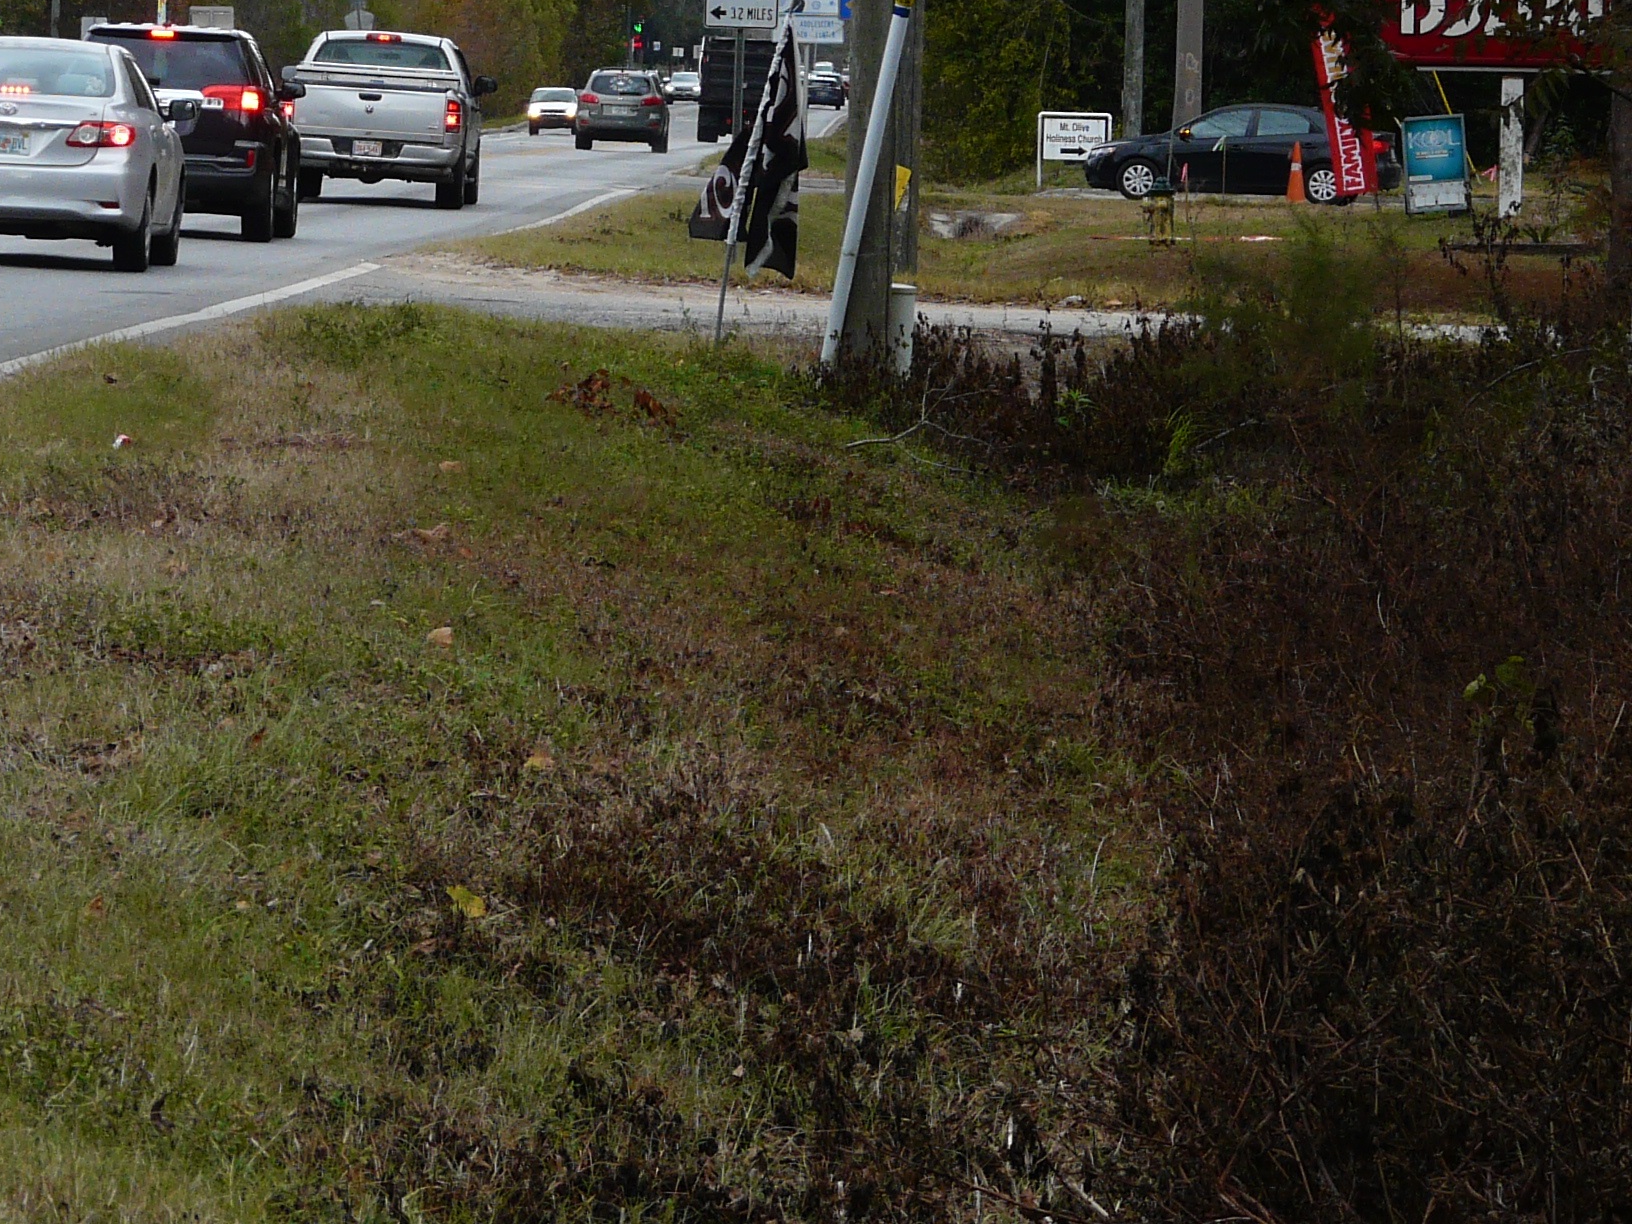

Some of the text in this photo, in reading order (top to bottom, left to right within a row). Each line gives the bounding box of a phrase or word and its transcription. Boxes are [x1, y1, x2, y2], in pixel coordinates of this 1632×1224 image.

[747, 7, 774, 21] MILES
[1046, 133, 1103, 144] Holiness Church
[1408, 129, 1461, 149] KOOL
